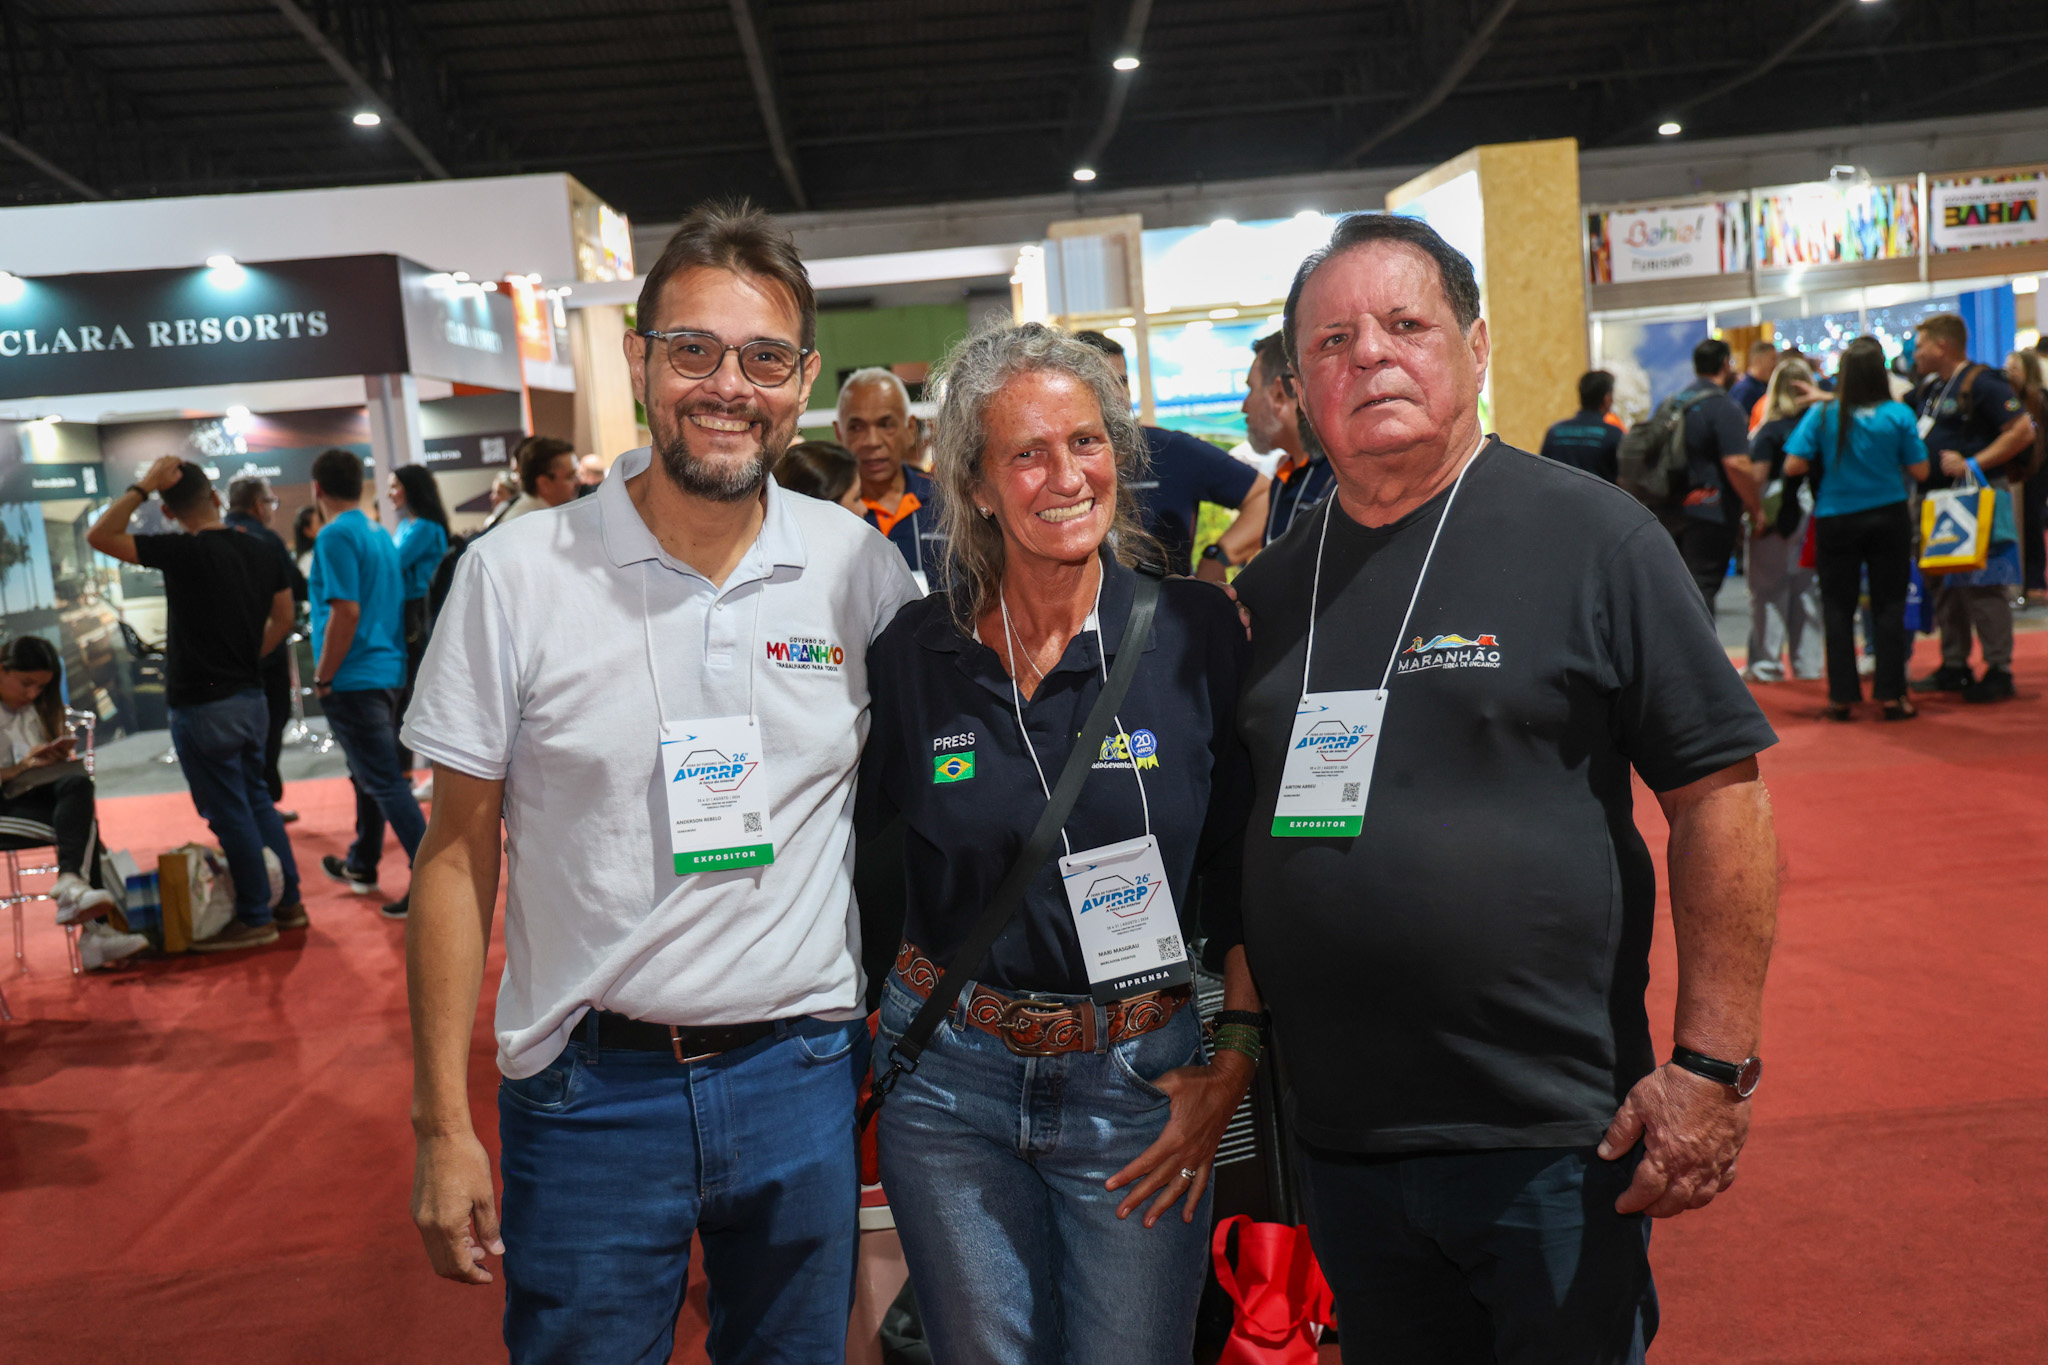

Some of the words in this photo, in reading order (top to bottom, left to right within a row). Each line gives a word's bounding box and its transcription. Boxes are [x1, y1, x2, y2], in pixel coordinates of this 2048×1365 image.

[1944, 199, 2037, 228] BAHIA
[0, 323, 135, 358] CLARA
[149, 310, 330, 349] RESORTS
[1398, 646, 1500, 671] MARANHÃO
[933, 732, 976, 751] PRESS
[1134, 733, 1151, 748] 20
[1137, 746, 1152, 754] ANOS
[1294, 735, 1360, 750] AVIRRP
[672, 763, 744, 783] AVIRRP
[1289, 820, 1346, 828] EXPOSITOR
[693, 850, 757, 864] EXPOSITOR
[1080, 885, 1148, 915] AVIRRP
[1113, 943, 1140, 954] MASGRAU
[1114, 970, 1170, 990] IMPRENSA
